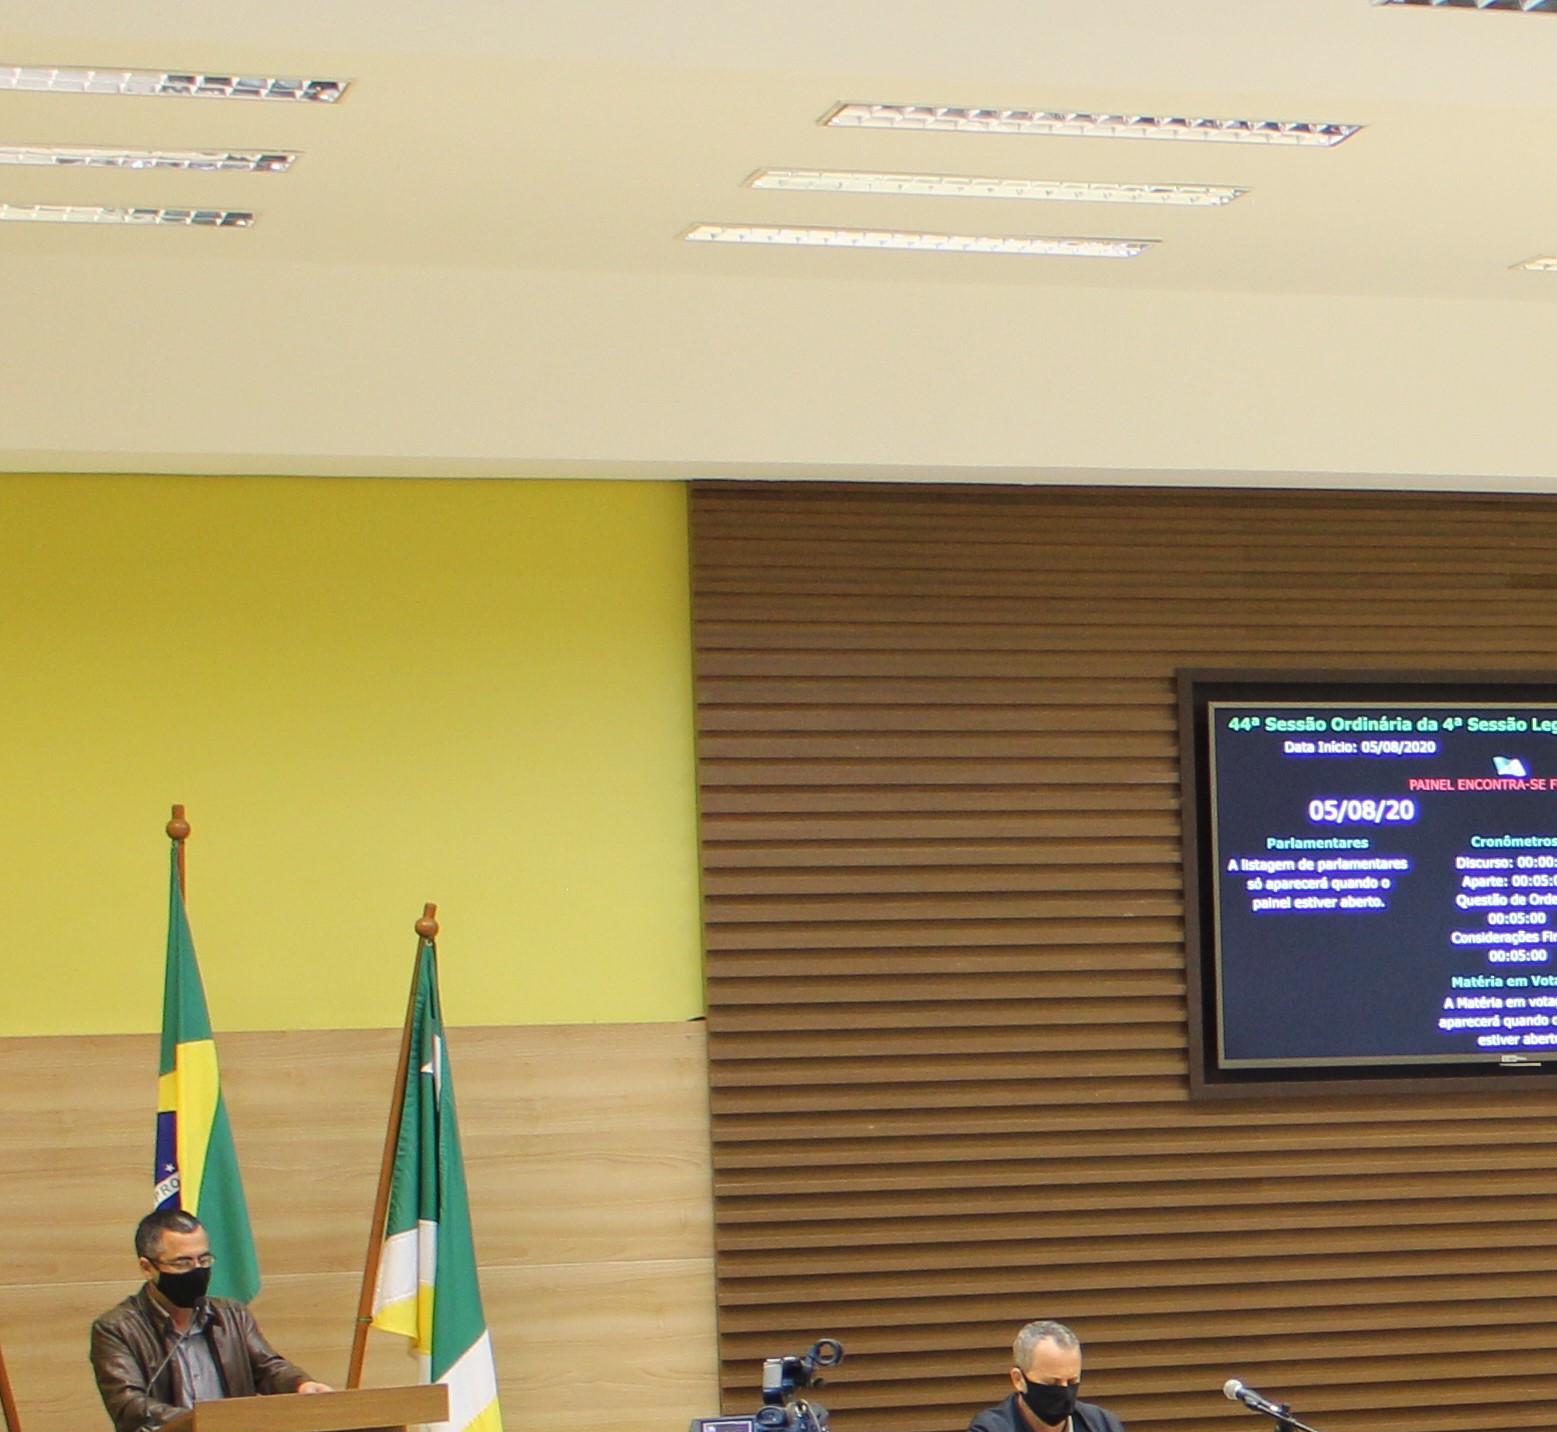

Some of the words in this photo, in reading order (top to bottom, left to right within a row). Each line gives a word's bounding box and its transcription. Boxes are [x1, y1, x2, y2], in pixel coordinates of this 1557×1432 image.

[1229, 717, 1260, 731] 44ª
[1264, 716, 1326, 731] Sessão
[1331, 716, 1412, 731] Ordinária
[1416, 717, 1438, 731] da
[1442, 717, 1463, 731] 4ª
[1467, 716, 1527, 731] Sessão
[1284, 741, 1314, 753] Data
[1361, 741, 1436, 754] 05/08/2020
[1409, 779, 1454, 790] PAINEL
[1458, 779, 1546, 790] ENCONTRA-SE
[1309, 799, 1415, 823] 05/08/20
[1266, 837, 1369, 849] Parlamentares
[1227, 859, 1238, 871] A
[1241, 857, 1295, 873] listagem
[1298, 858, 1314, 870] de
[1317, 857, 1409, 872] parlamentares
[1456, 856, 1514, 869] Discurso:
[1247, 877, 1262, 890] só
[1266, 876, 1328, 892] aparecerá
[1331, 876, 1378, 891] quando
[1381, 879, 1391, 888] o
[1462, 875, 1508, 890] Aparte:
[1252, 896, 1291, 911] painel
[1294, 897, 1337, 908] estiver
[1340, 896, 1385, 908] aberto.
[1456, 894, 1507, 909] Questão
[1510, 894, 1526, 905] de
[1487, 912, 1547, 924] 00:05:00
[1451, 930, 1539, 945] Considerações
[1488, 949, 1548, 962] 00:05:00
[1451, 975, 1503, 988] Matéria
[1506, 978, 1528, 987] em
[1443, 997, 1454, 1009] A
[1456, 996, 1503, 1009] Matéria
[1505, 999, 1525, 1008] em
[1438, 1015, 1500, 1030] aparecerá
[1503, 1014, 1549, 1029] quando
[1477, 1034, 1520, 1046] estiver
